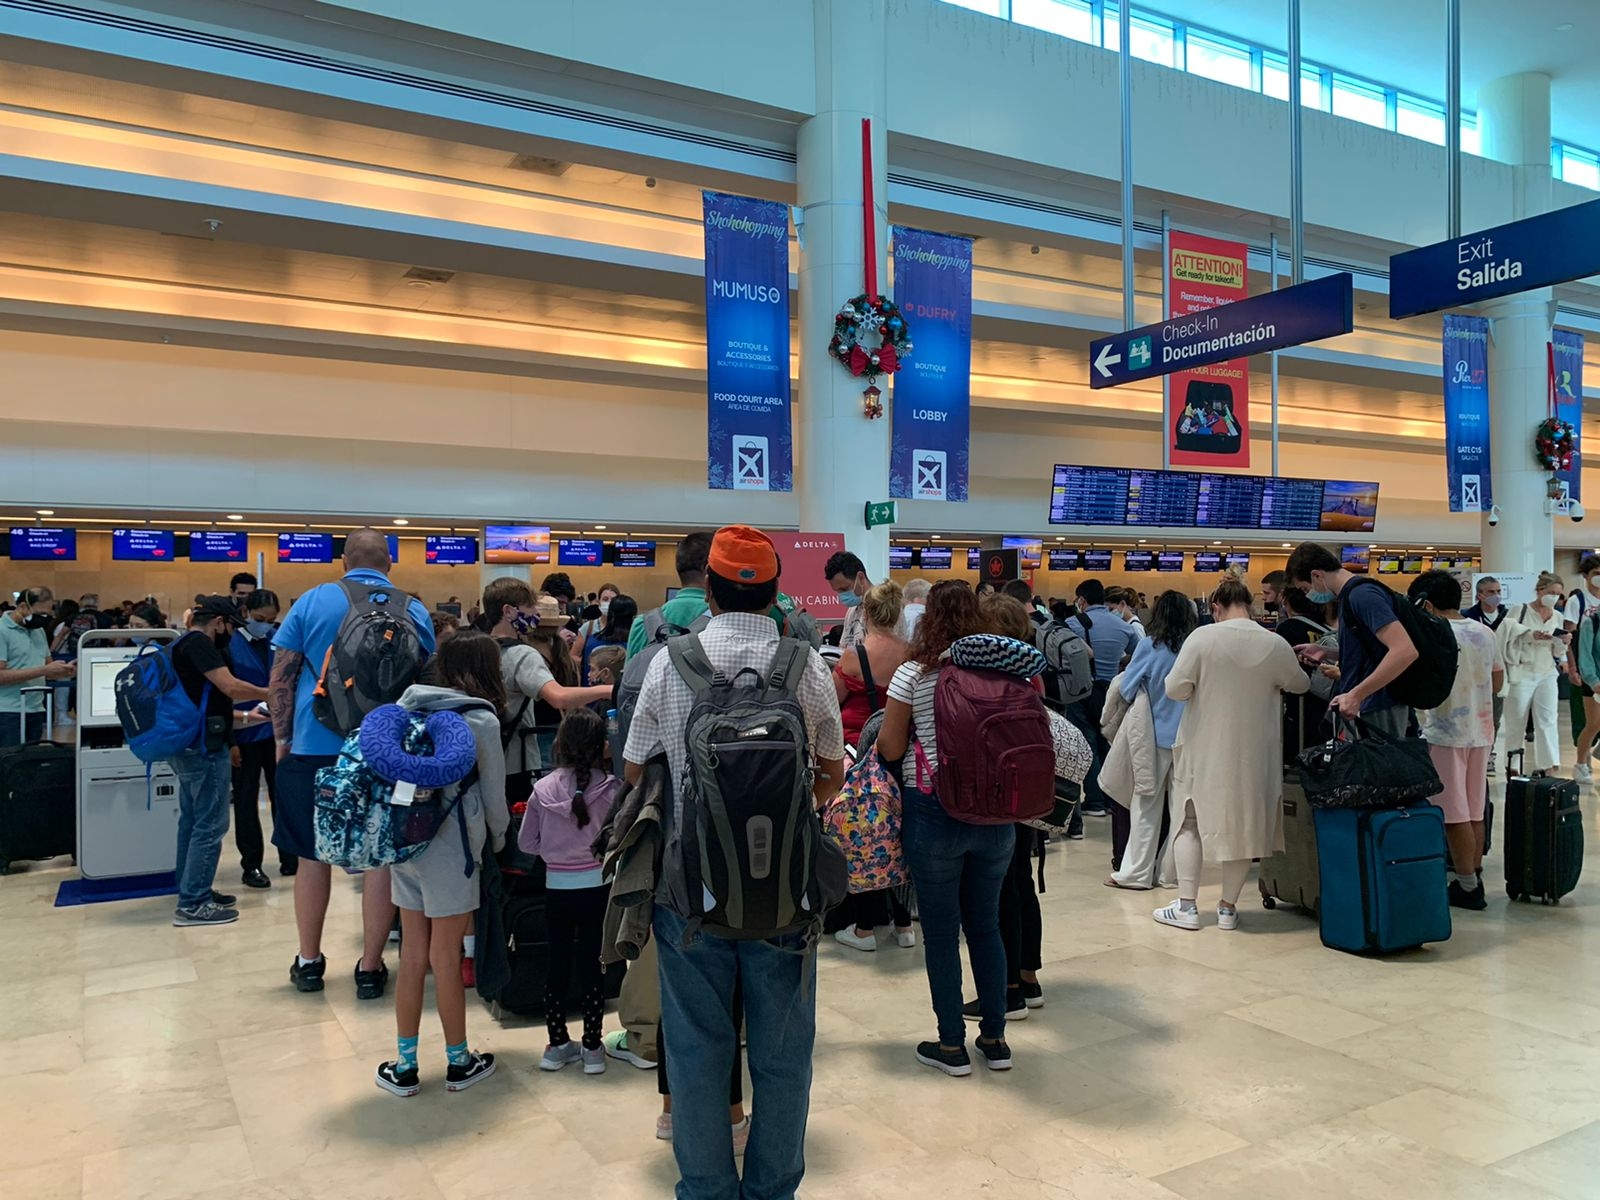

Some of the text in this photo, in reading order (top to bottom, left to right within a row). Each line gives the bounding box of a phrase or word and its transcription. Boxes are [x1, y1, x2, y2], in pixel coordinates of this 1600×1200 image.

[706, 210, 785, 242] Shohohopping
[895, 243, 970, 273] Shohohopping
[1458, 238, 1493, 264] Exit
[1174, 253, 1242, 278] ATTENTION!
[1175, 268, 1188, 278] Get
[1188, 271, 1204, 282] ready
[1205, 272, 1214, 281] for
[1457, 258, 1522, 290] Salida
[713, 279, 780, 303] MUMUSO
[917, 304, 957, 320] DUFRY
[1162, 314, 1219, 342] Check-In
[727, 341, 769, 352] BOUTIQUE &
[1162, 323, 1276, 363] Documentación
[725, 351, 772, 362] ACCESSORIES
[914, 362, 947, 373] BOUTIQUE
[1209, 367, 1243, 379] LUGGAGE!
[714, 392, 784, 406] FOOD COURT AREA
[912, 409, 948, 422] LOBBY
[10, 528, 24, 536] 46
[113, 529, 126, 537] 47
[806, 595, 840, 606] CABIN
